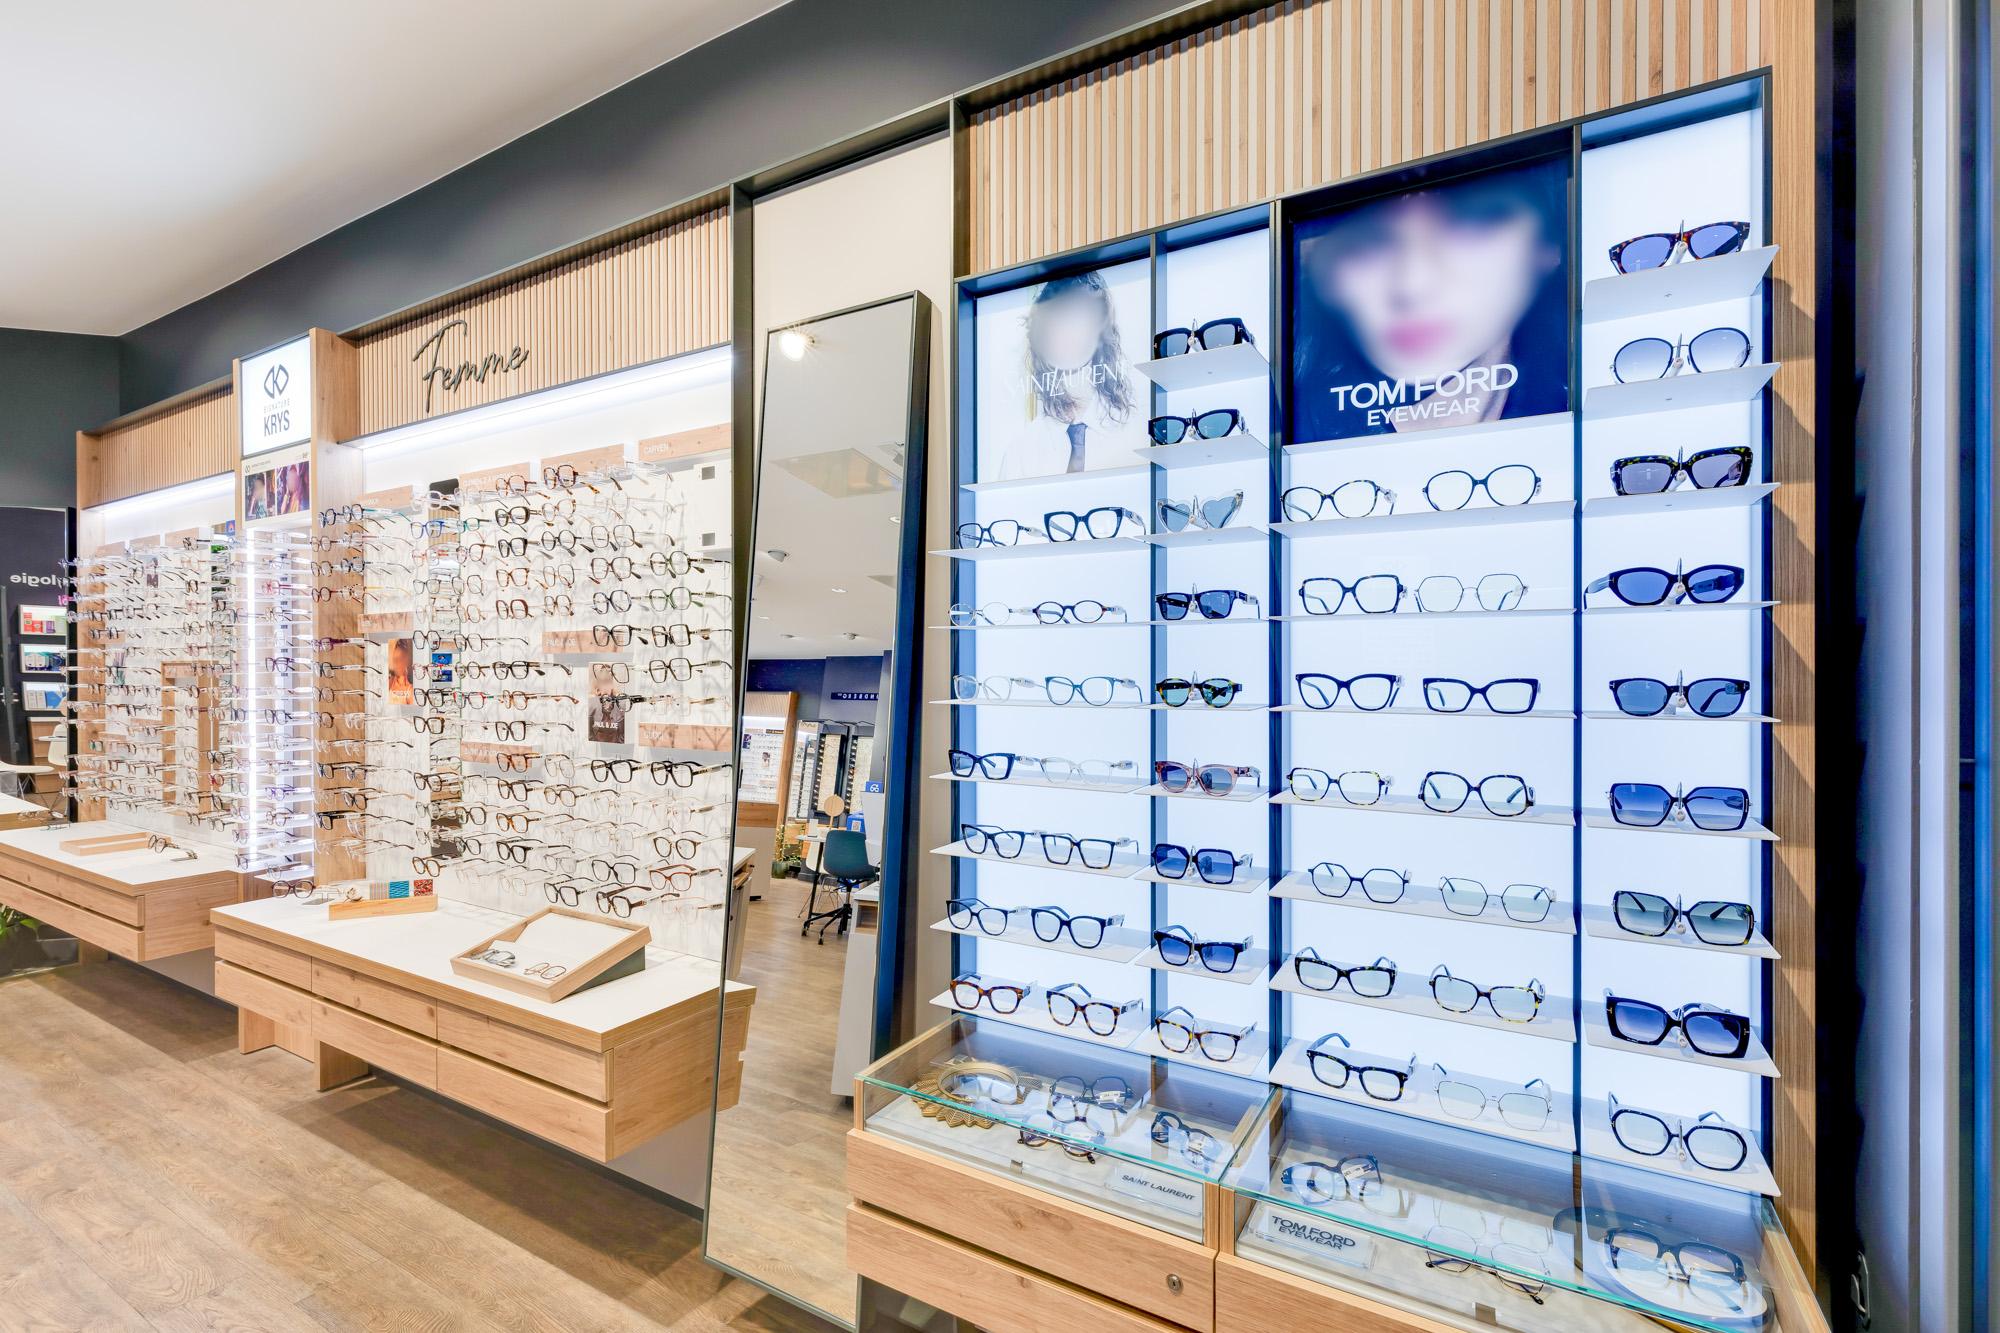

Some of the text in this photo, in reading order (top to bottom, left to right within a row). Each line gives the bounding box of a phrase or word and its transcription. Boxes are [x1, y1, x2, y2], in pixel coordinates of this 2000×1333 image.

[412, 319, 529, 413] Femme
[1330, 363, 1519, 411] TOM FORD
[263, 409, 290, 437] KRYS
[1367, 398, 1481, 426] EYEWEAR
[1122, 1175, 1196, 1200] SAINT LAURENT
[1272, 1215, 1356, 1247] TOM FORD
[1279, 1226, 1342, 1250] EYEWEAR
